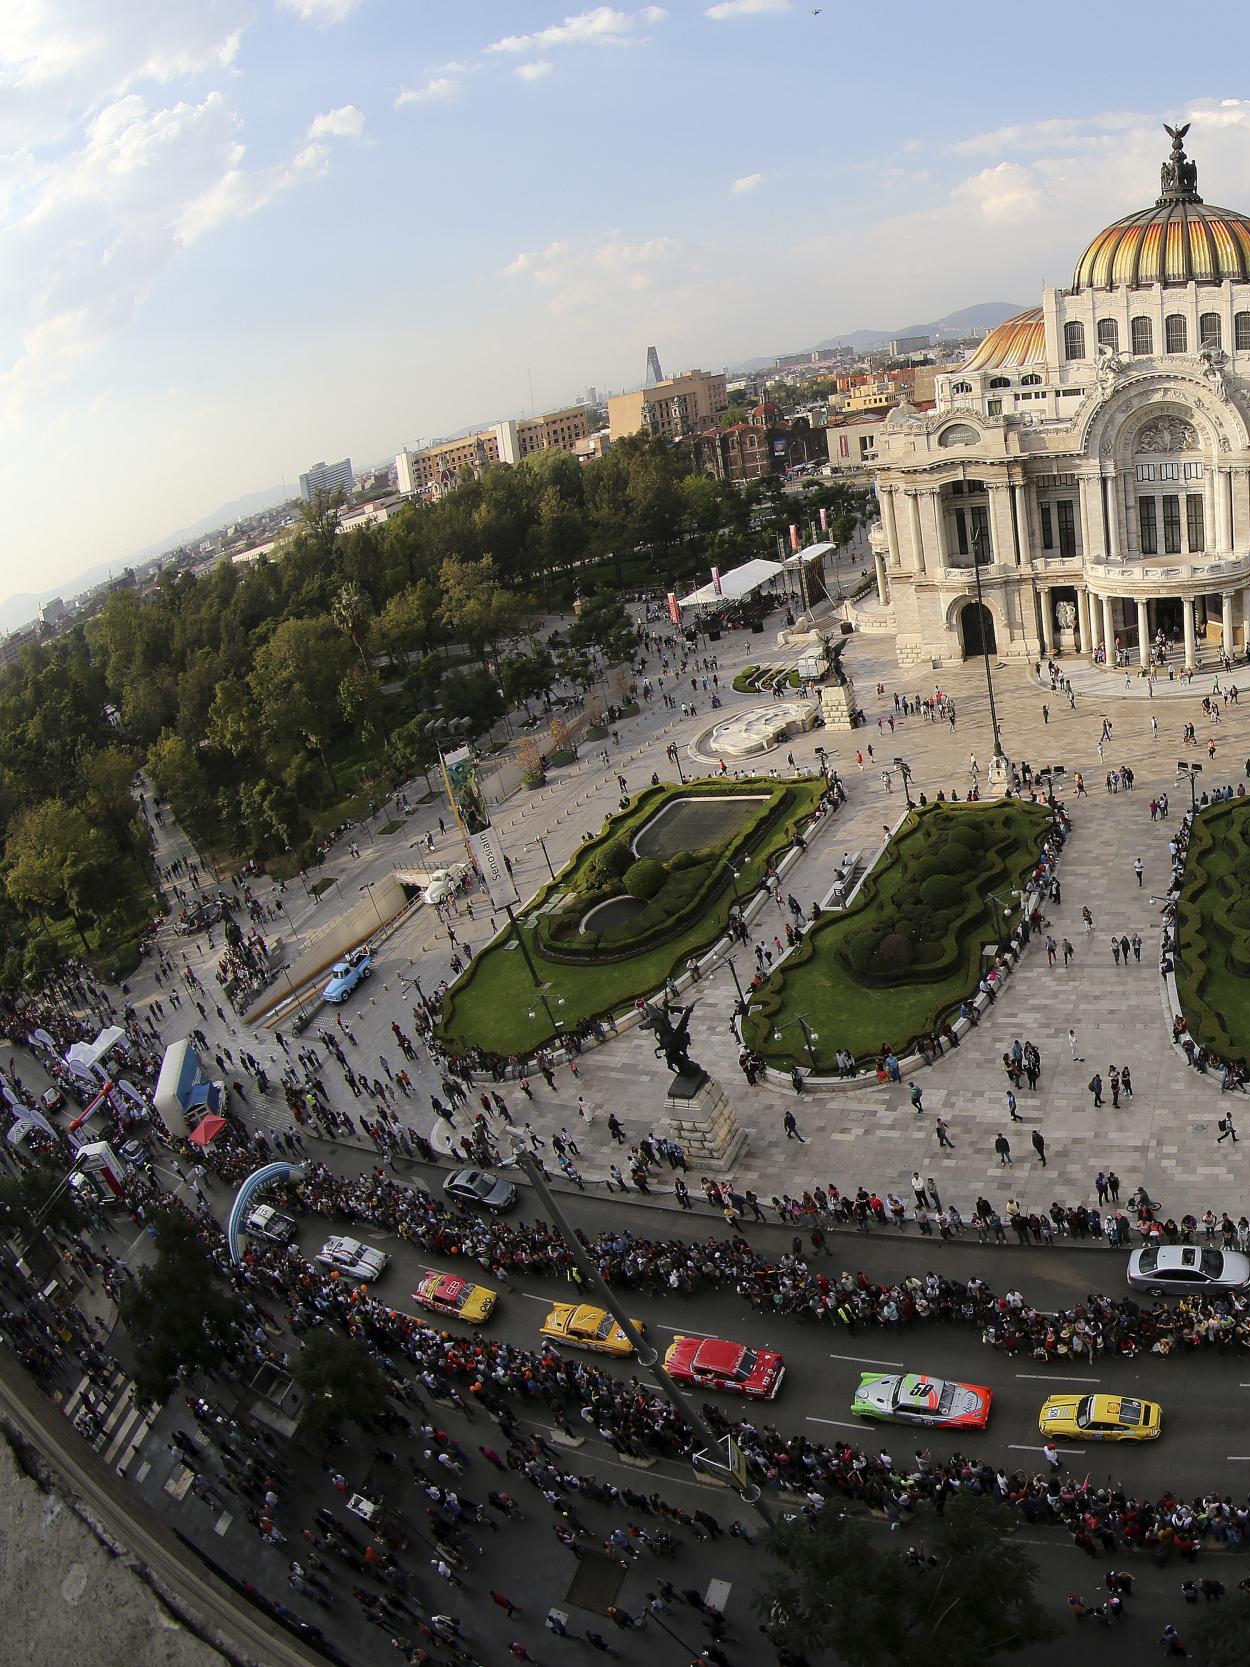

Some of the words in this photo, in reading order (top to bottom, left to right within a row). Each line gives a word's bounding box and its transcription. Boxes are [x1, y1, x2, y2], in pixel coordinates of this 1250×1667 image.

[1195, 421, 1212, 447] ARTES
[480, 833, 501, 881] Senosiain
[909, 1382, 934, 1398] 59
